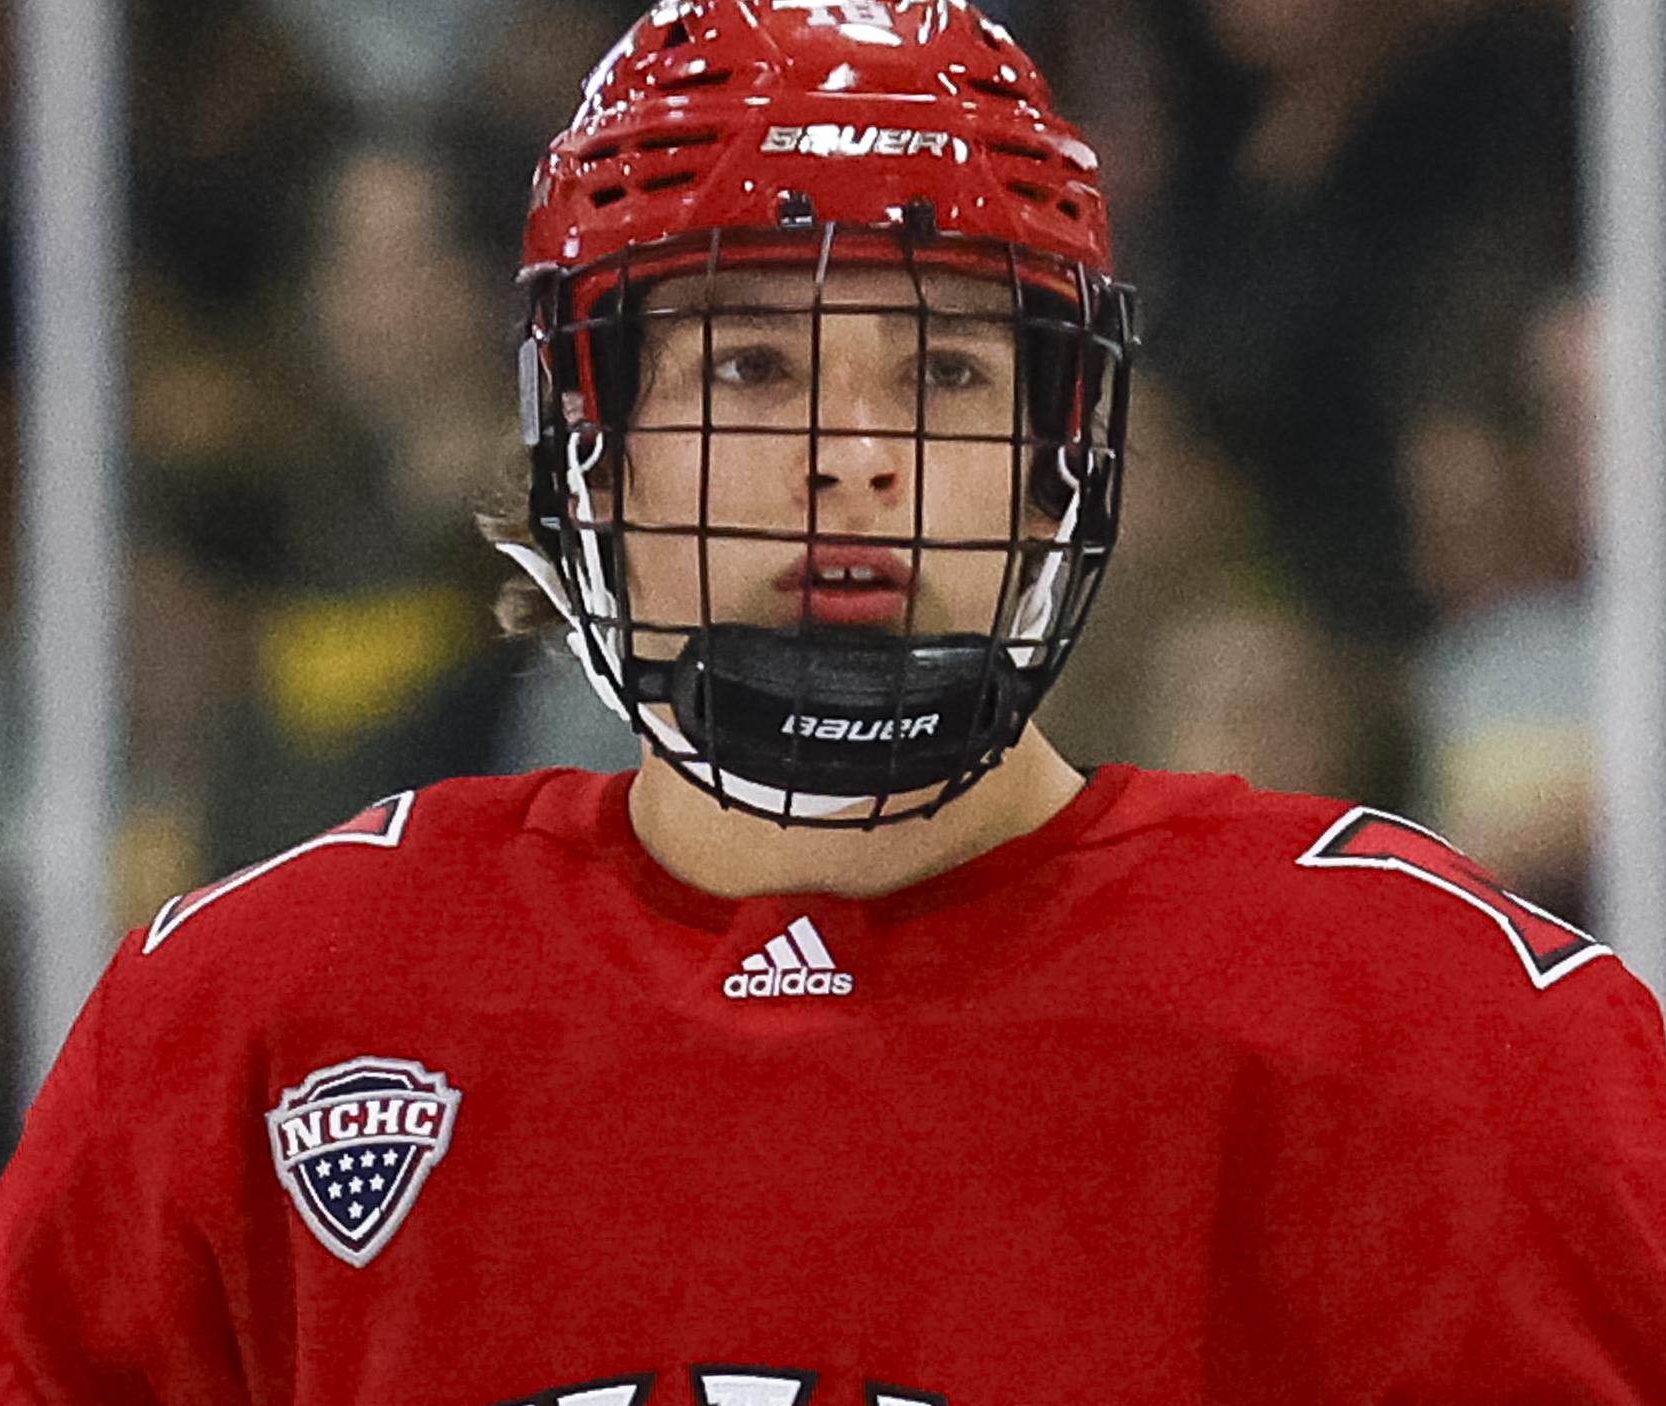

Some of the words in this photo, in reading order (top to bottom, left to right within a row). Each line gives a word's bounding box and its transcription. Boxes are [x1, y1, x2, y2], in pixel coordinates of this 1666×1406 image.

[760, 124, 949, 157] BAUER
[781, 713, 940, 741] BAUER
[722, 966, 854, 998] adidas
[282, 1099, 439, 1156] NCHC
